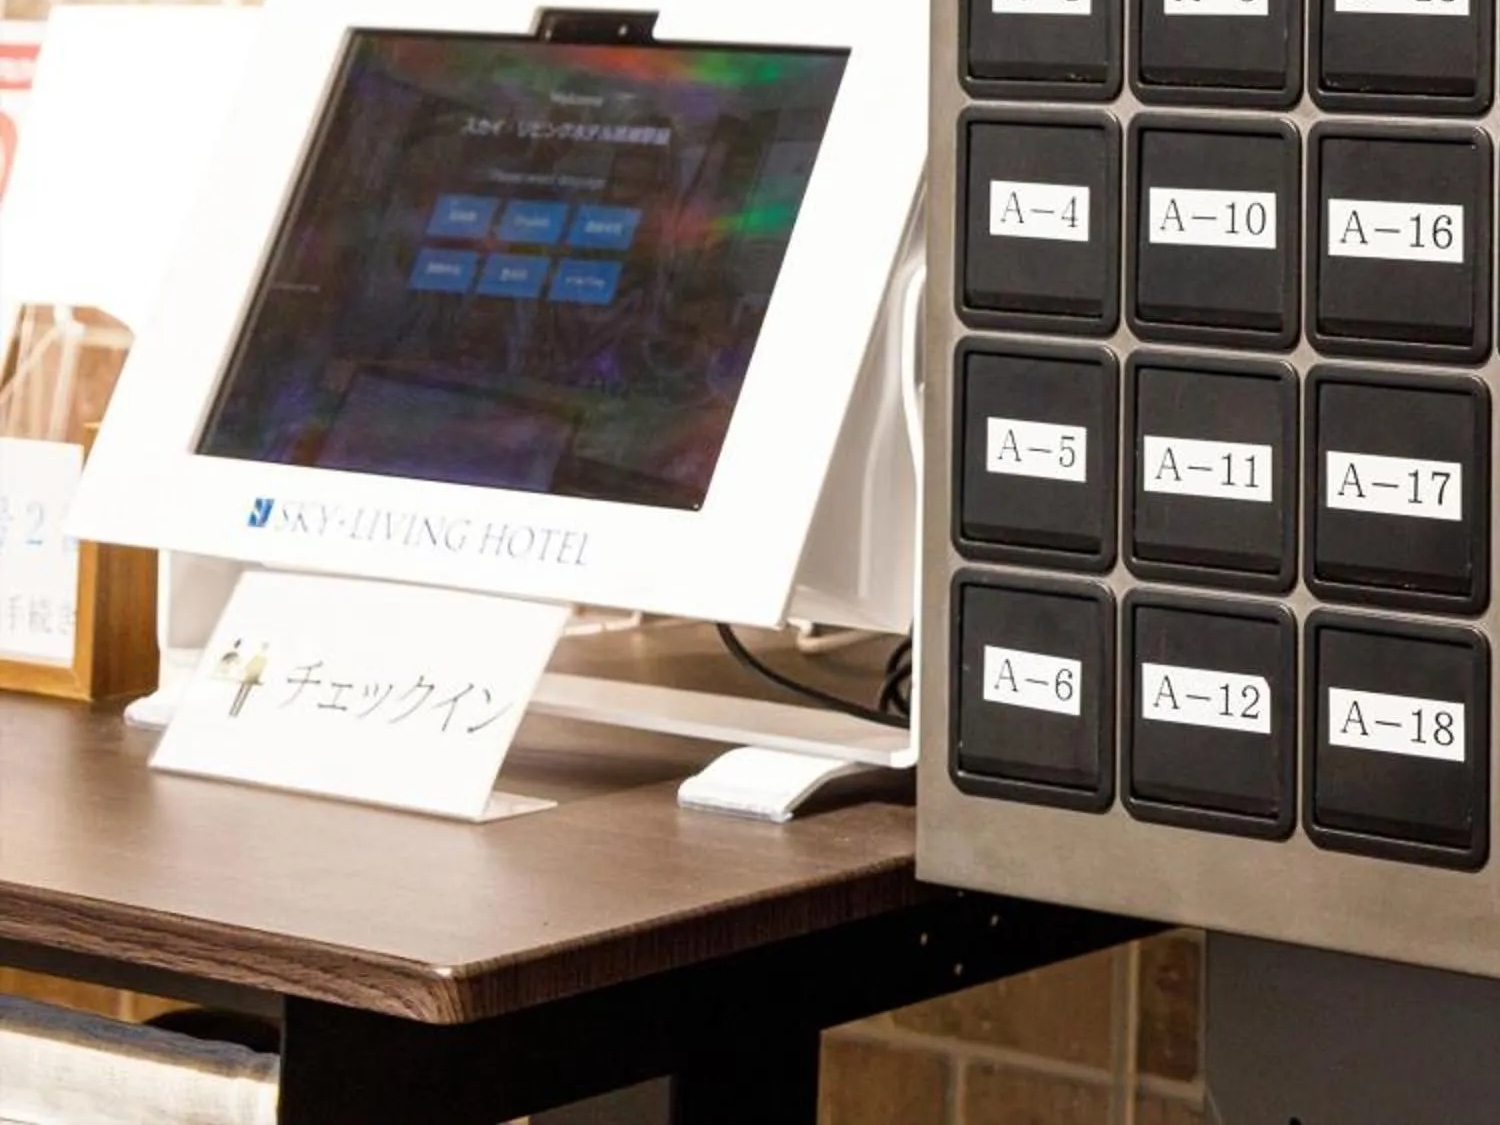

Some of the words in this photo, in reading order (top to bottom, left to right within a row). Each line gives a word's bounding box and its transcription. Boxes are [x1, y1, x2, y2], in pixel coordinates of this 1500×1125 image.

[1002, 192, 1076, 228] A-4
[1160, 199, 1266, 235] A-10
[1340, 210, 1453, 250] A-16
[998, 430, 1075, 468] A-5
[1156, 447, 1258, 488] A-11
[1338, 462, 1451, 506] A-17
[478, 523, 590, 566] HOTEL
[277, 660, 514, 733] チェックイン
[995, 659, 1073, 700] A-6
[1154, 675, 1260, 720] A-12
[1341, 700, 1455, 746] A-18
